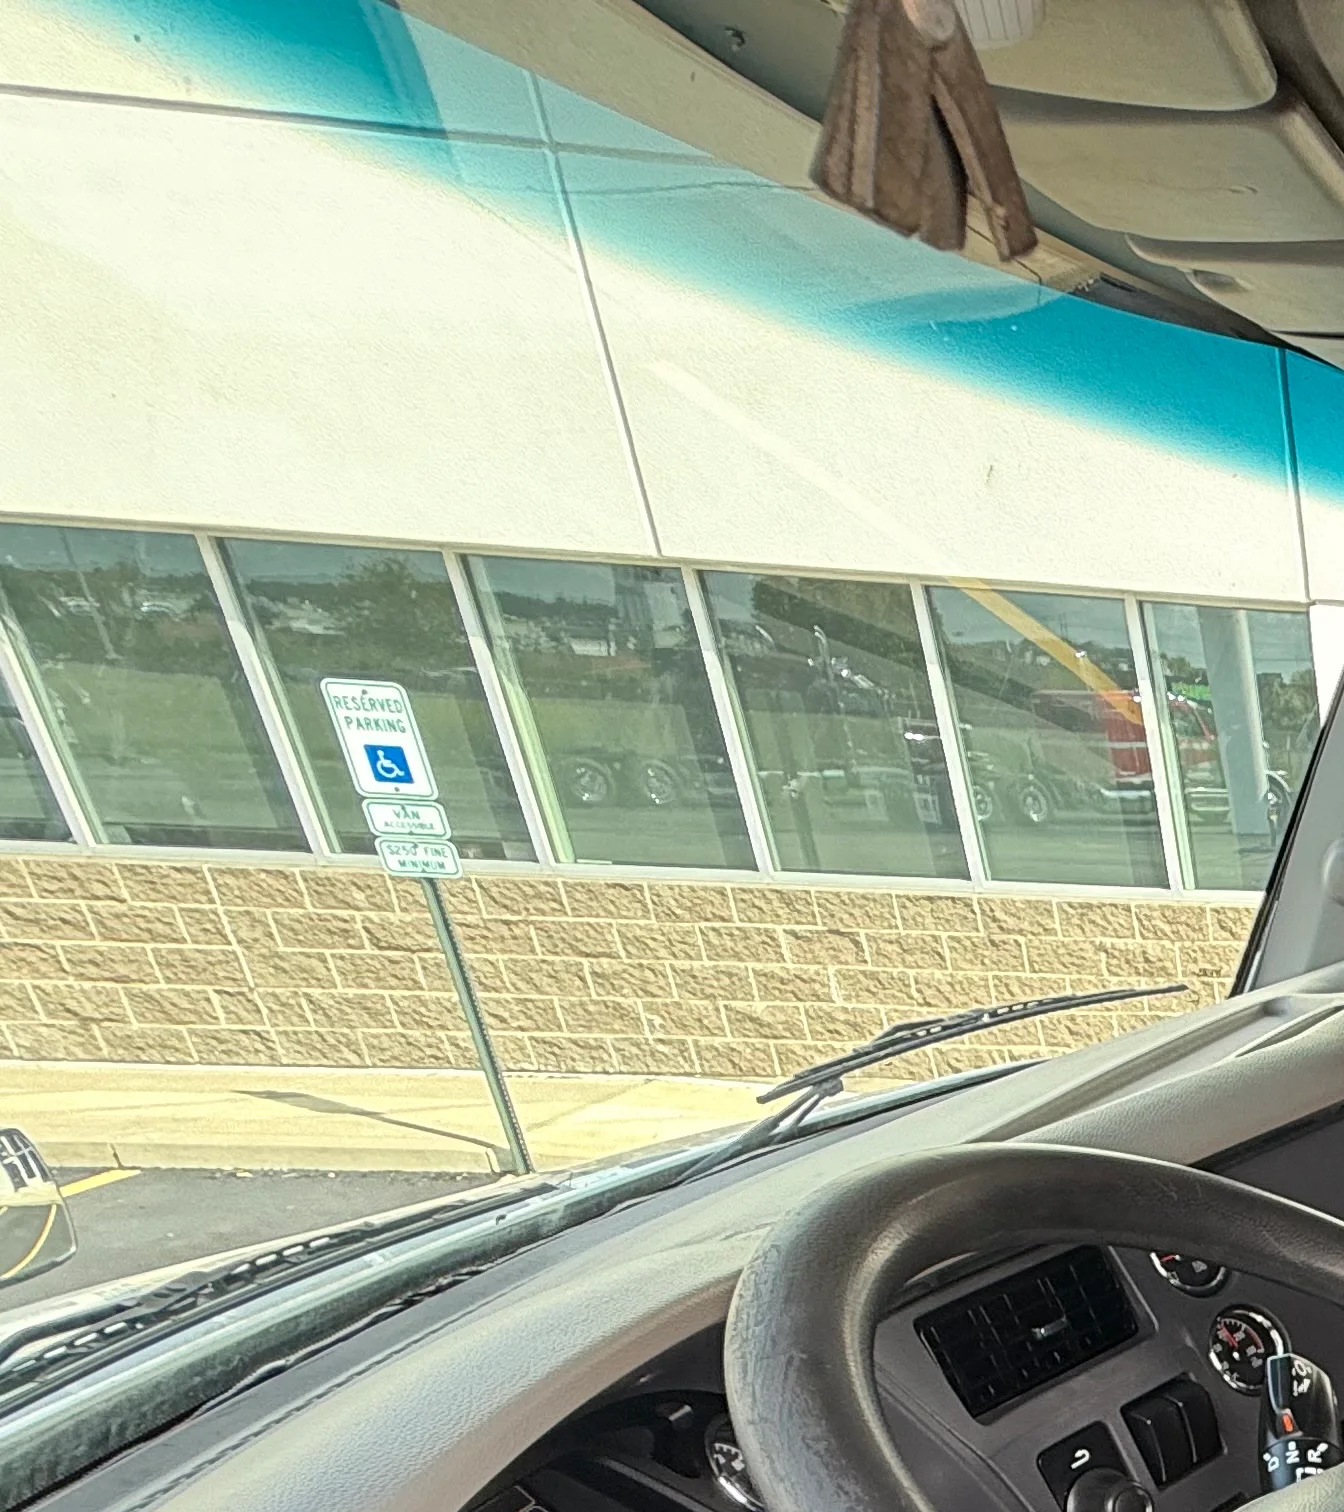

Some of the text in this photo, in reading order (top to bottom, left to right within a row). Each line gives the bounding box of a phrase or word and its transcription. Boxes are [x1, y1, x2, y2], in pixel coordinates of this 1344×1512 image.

[332, 695, 404, 714] RESERVED
[344, 715, 407, 734] PARKING
[392, 807, 421, 820] VAN
[424, 846, 449, 859] FINE
[1285, 1450, 1300, 1465] N
[1307, 1449, 1323, 1464] R
[1267, 1456, 1280, 1473] D
